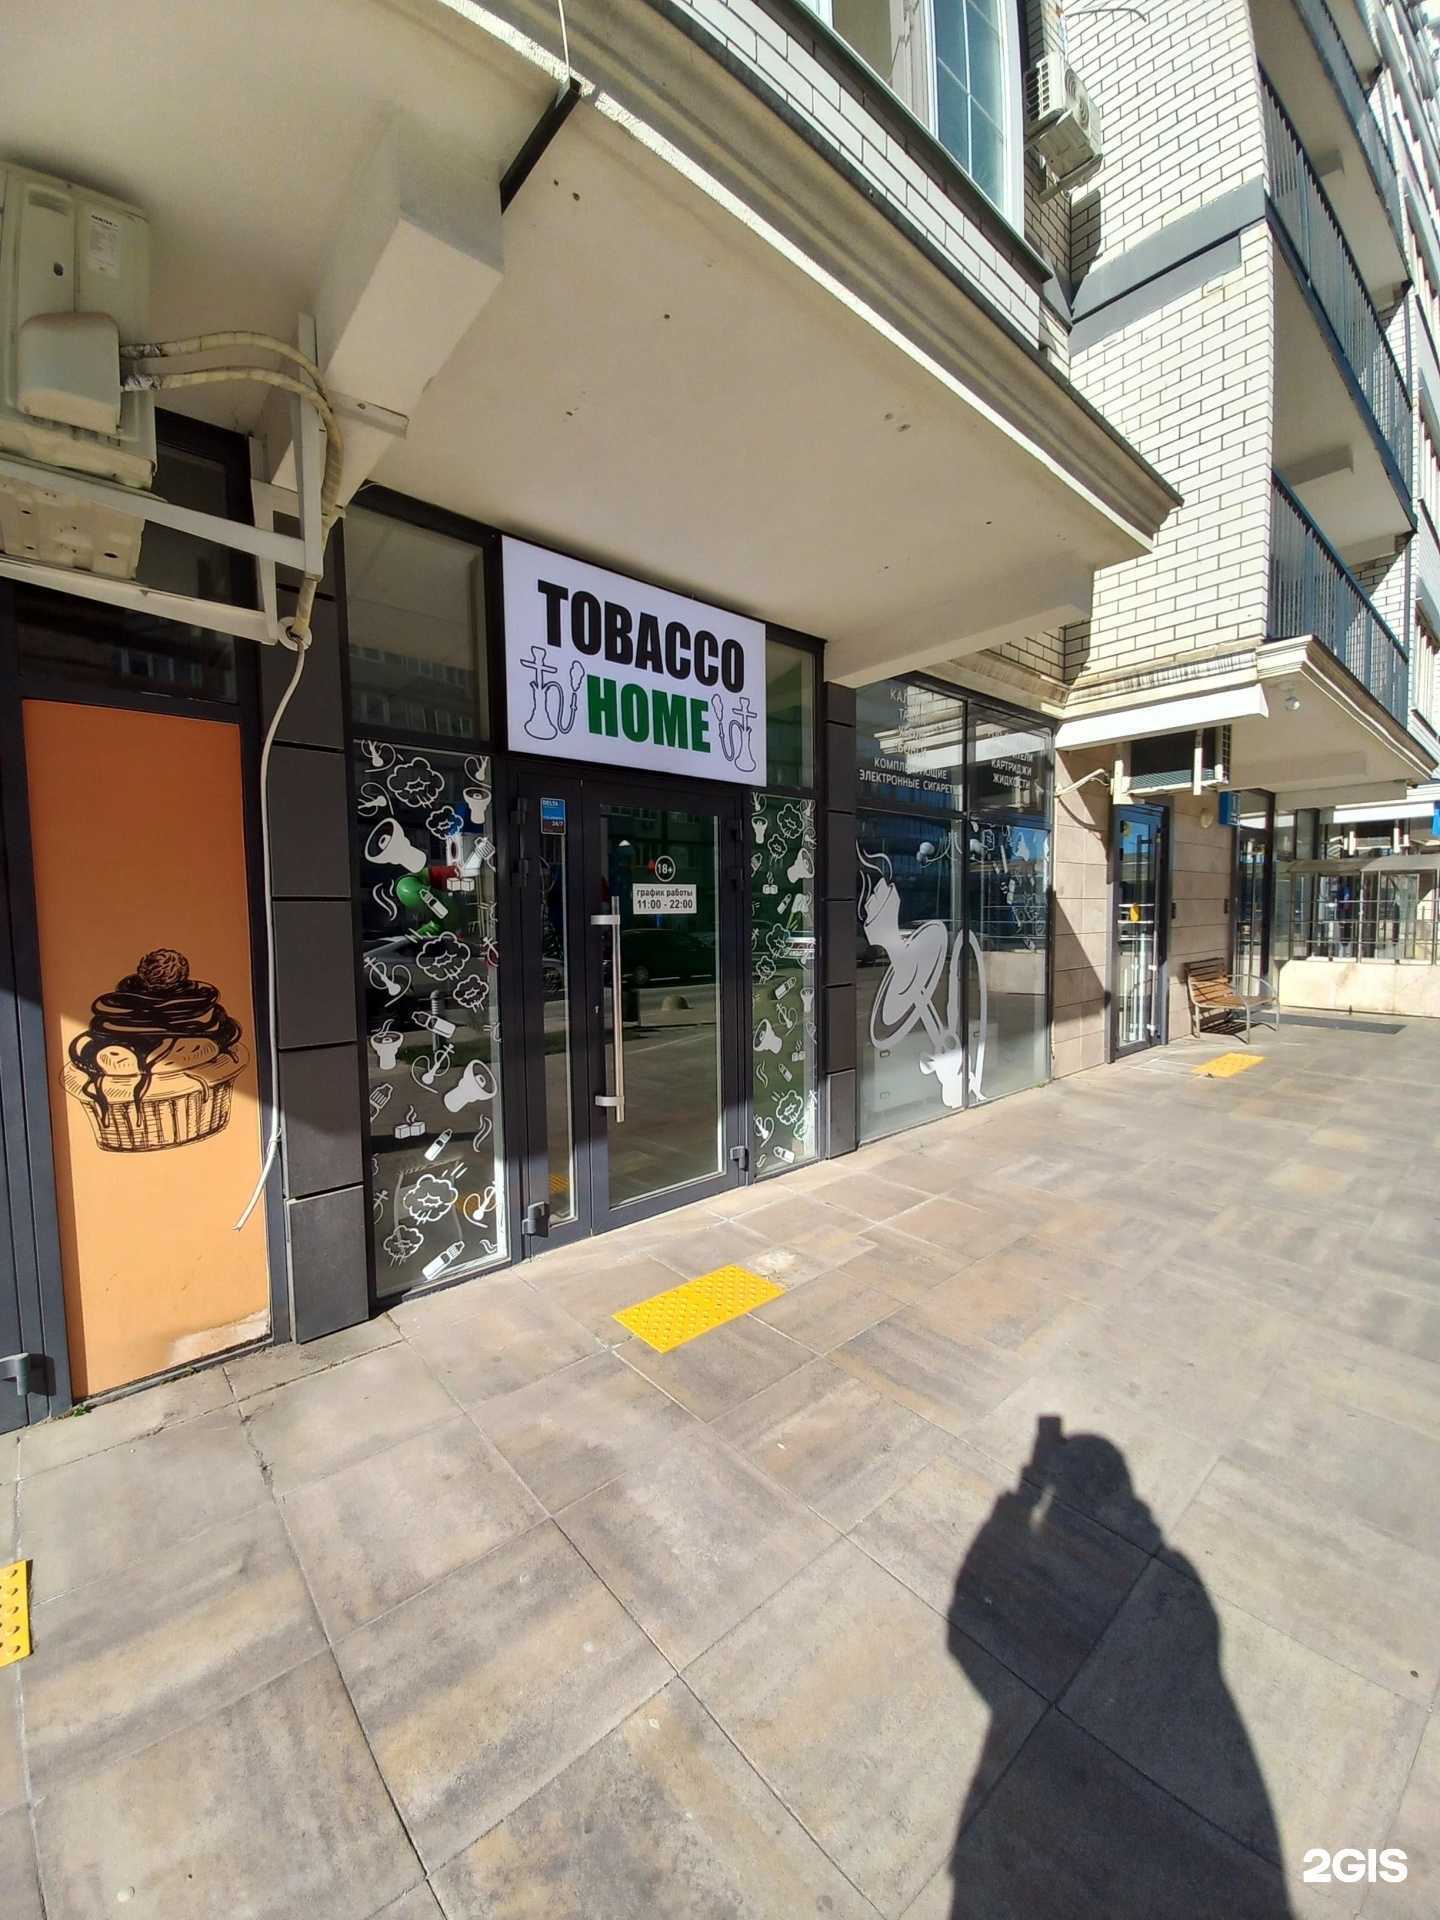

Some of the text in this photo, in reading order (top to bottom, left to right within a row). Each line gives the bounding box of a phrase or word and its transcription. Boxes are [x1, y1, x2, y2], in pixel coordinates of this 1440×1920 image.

[537, 579, 744, 693] TOBACCO
[586, 674, 711, 753] HOME
[874, 757, 948, 779] КОМПЛЮЩИЕ
[991, 759, 1032, 776] КАРТРИДЖИ
[859, 769, 960, 795] ЭЛЕКТРОННЫЕ СИГАРЕТ
[657, 863, 673, 874] 18+
[636, 888, 693, 898] график работы
[637, 899, 661, 909] 11:00
[669, 899, 693, 909] 22:00
